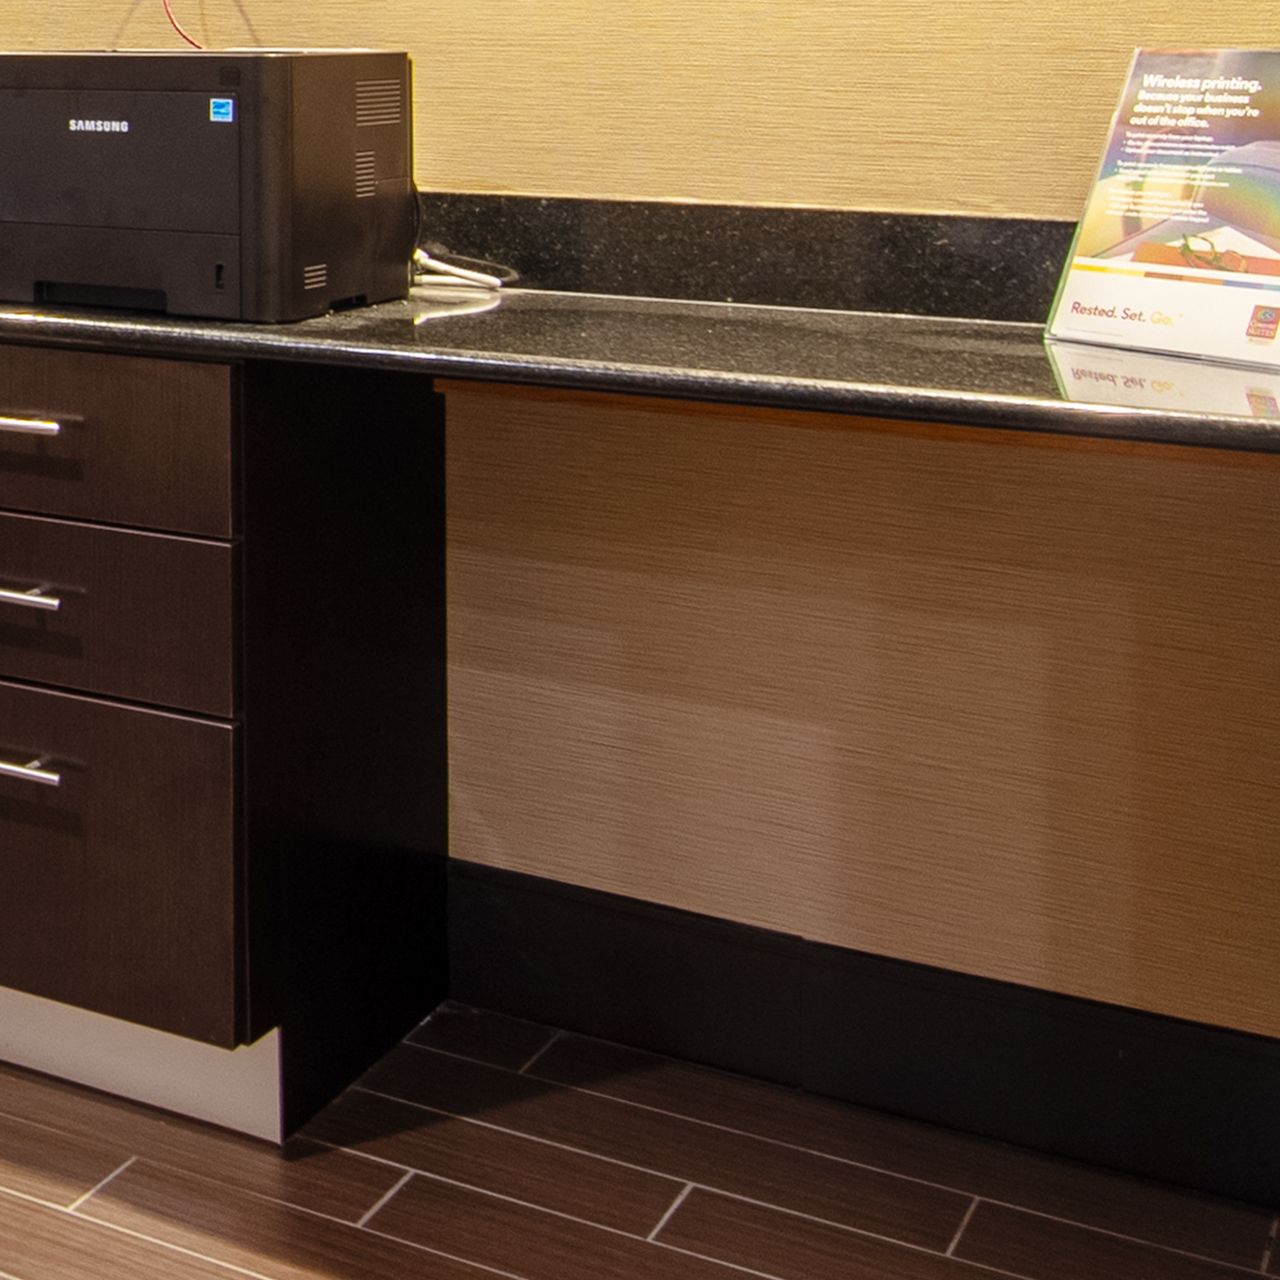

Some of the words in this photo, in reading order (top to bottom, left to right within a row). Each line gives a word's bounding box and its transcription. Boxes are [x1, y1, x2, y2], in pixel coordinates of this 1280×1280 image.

[1143, 73, 1200, 88] Wireless
[1200, 75, 1262, 94] printing.
[1137, 89, 1179, 101] Because
[1179, 93, 1203, 103] your
[1203, 91, 1250, 104] business
[1172, 104, 1196, 117] stop
[1196, 105, 1224, 116] when
[68, 118, 129, 133] SAMSUNG
[1129, 115, 1147, 126] out
[1147, 116, 1159, 127] of
[1159, 116, 1177, 127] the
[1177, 116, 1210, 129] office.
[1070, 301, 1117, 319] Rested.
[1121, 307, 1146, 322] Set.
